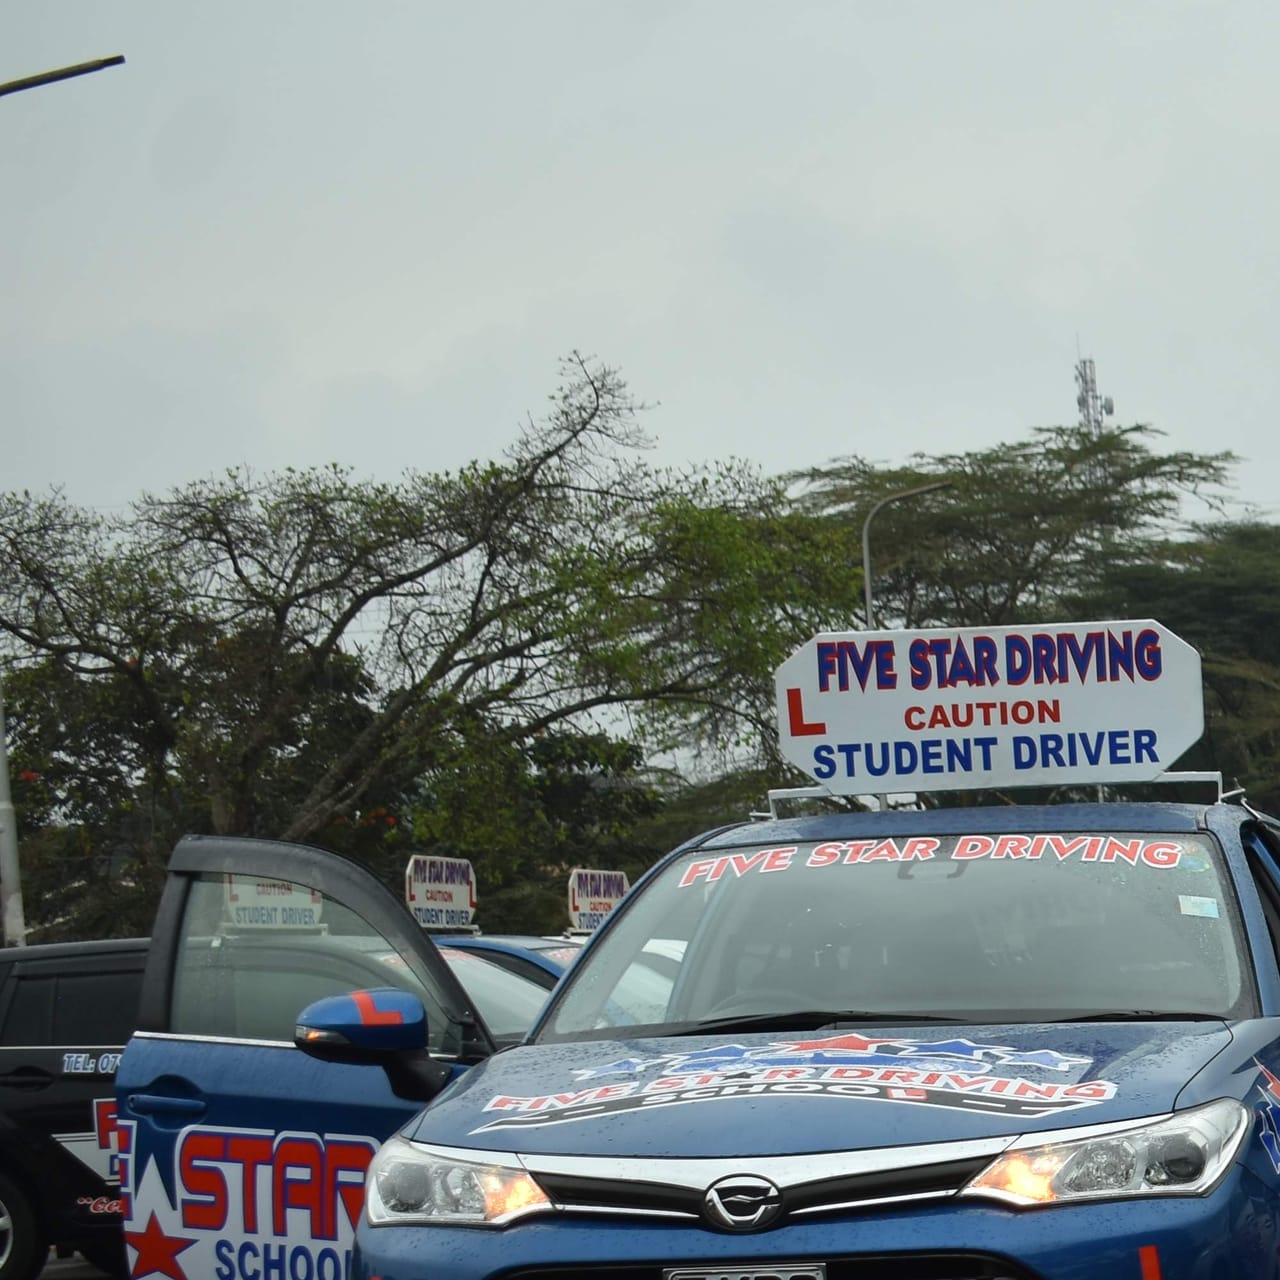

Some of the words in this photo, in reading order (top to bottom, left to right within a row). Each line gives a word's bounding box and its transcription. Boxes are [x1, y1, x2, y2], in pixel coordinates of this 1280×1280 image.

[817, 640, 897, 693] FIVE
[909, 634, 999, 690] STAR
[1005, 628, 1163, 686] DRIVING
[787, 688, 827, 736] L
[904, 699, 1061, 731] CAUTION
[813, 737, 998, 779] STUDENT
[1013, 729, 1160, 770] DRIVER
[678, 847, 798, 888] FIVE
[806, 837, 942, 867] STAR
[951, 835, 1182, 868] DRIVING
[425, 889, 453, 903] CAUTION
[590, 902, 612, 912] CAUTION
[235, 906, 278, 925] STUDENT
[281, 907, 315, 926] DRIVER
[414, 908, 443, 924] STUDENT
[445, 909, 469, 925] DRIVER
[350, 990, 402, 1026] L
[63, 1053, 96, 1073] TEL:
[99, 1053, 123, 1073] 07
[481, 1081, 641, 1113] FIVE
[828, 1066, 1120, 1101] DRIVING
[643, 1081, 928, 1105] SCHOOL
[178, 1129, 378, 1243] STAR
